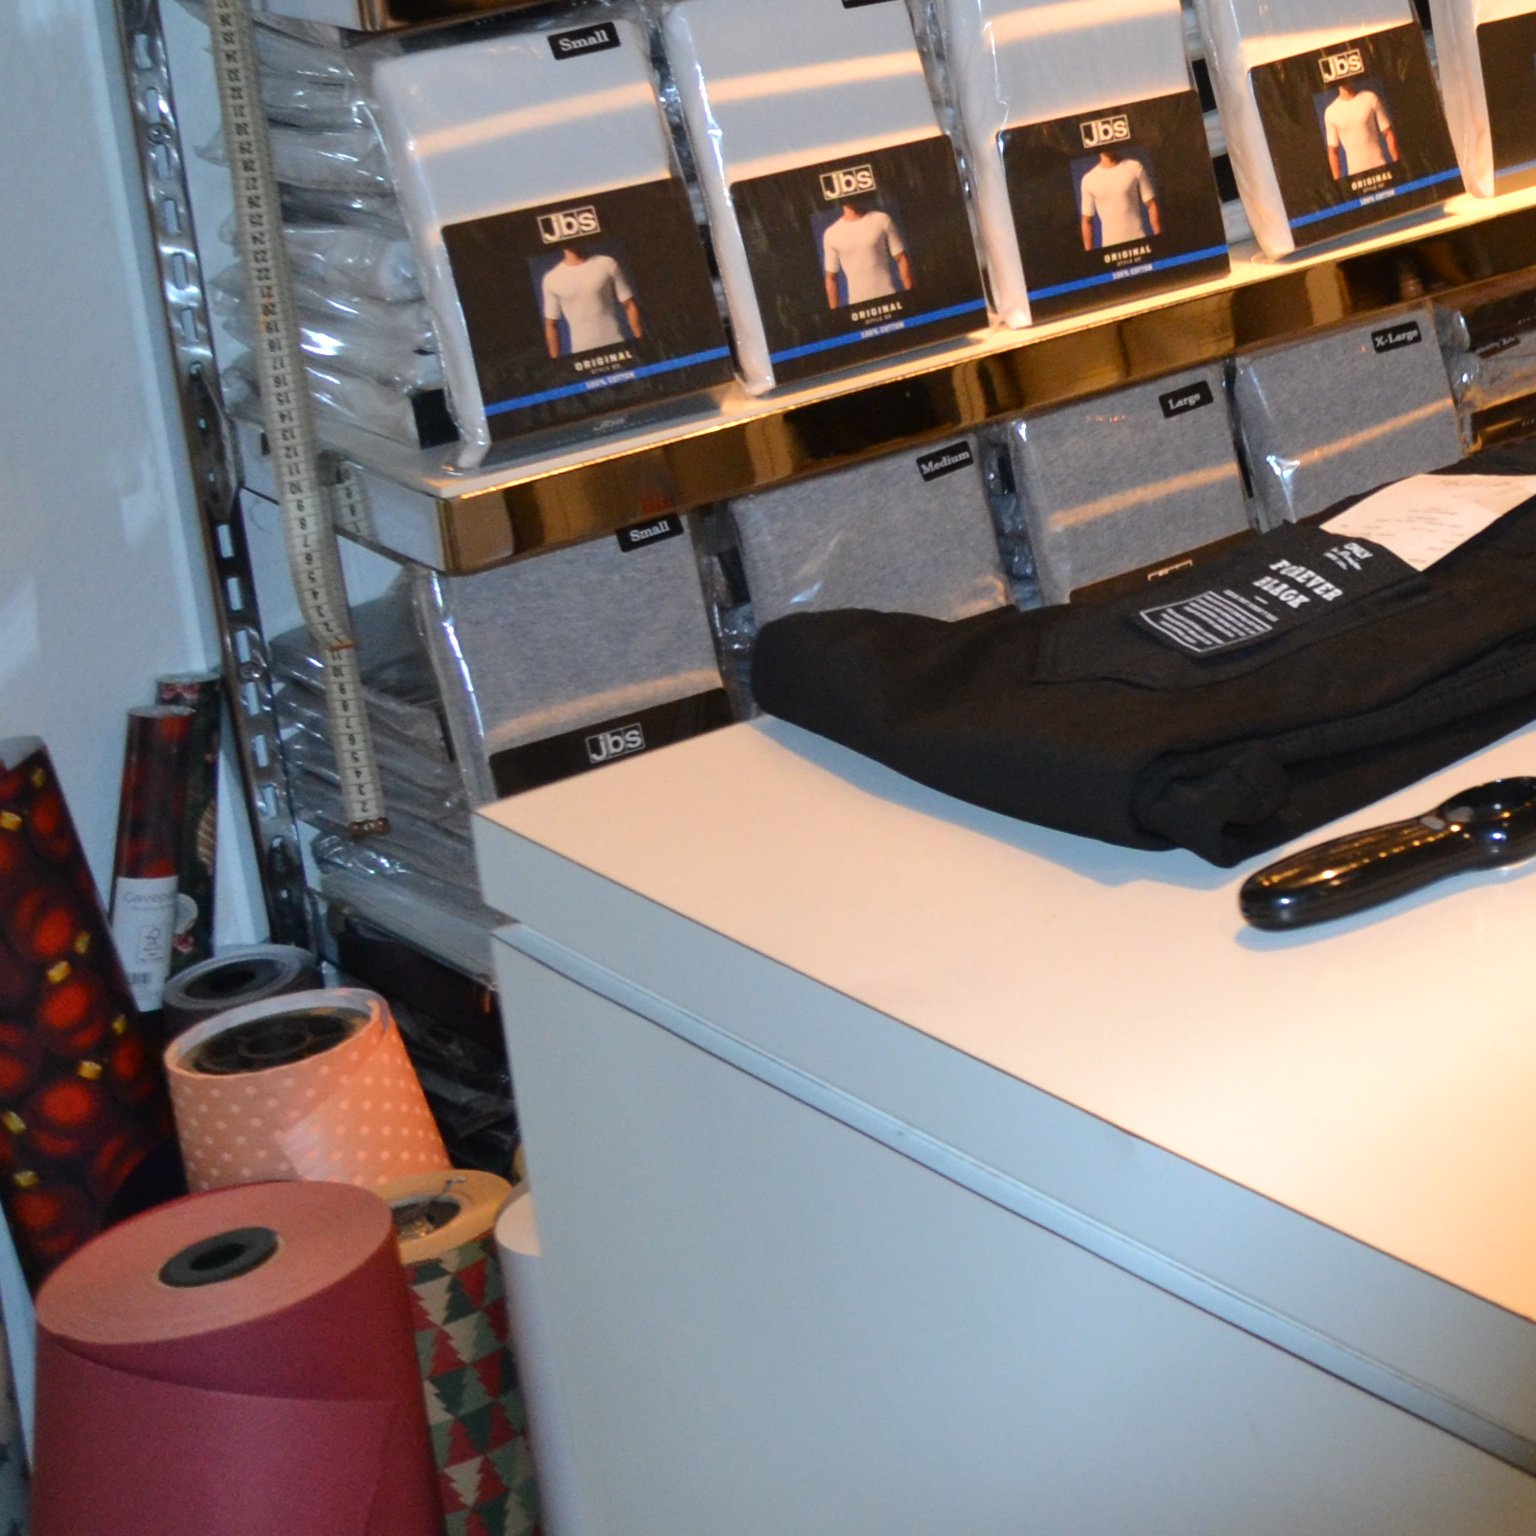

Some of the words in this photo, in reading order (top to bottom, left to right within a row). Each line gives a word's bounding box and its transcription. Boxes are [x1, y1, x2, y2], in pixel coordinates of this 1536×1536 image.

[560, 30, 609, 53] Small
[1351, 171, 1393, 191] ORIGINAL
[1103, 245, 1151, 263] ORIGINAL
[852, 301, 903, 321] ORIGINAL
[1374, 328, 1418, 347] X-Large
[575, 350, 632, 371] ORIGINAL
[1167, 393, 1200, 410] Large
[921, 450, 970, 474] Medium
[630, 520, 669, 542] Small
[1269, 559, 1343, 601] FOREVER
[1252, 576, 1311, 608] BLACK
